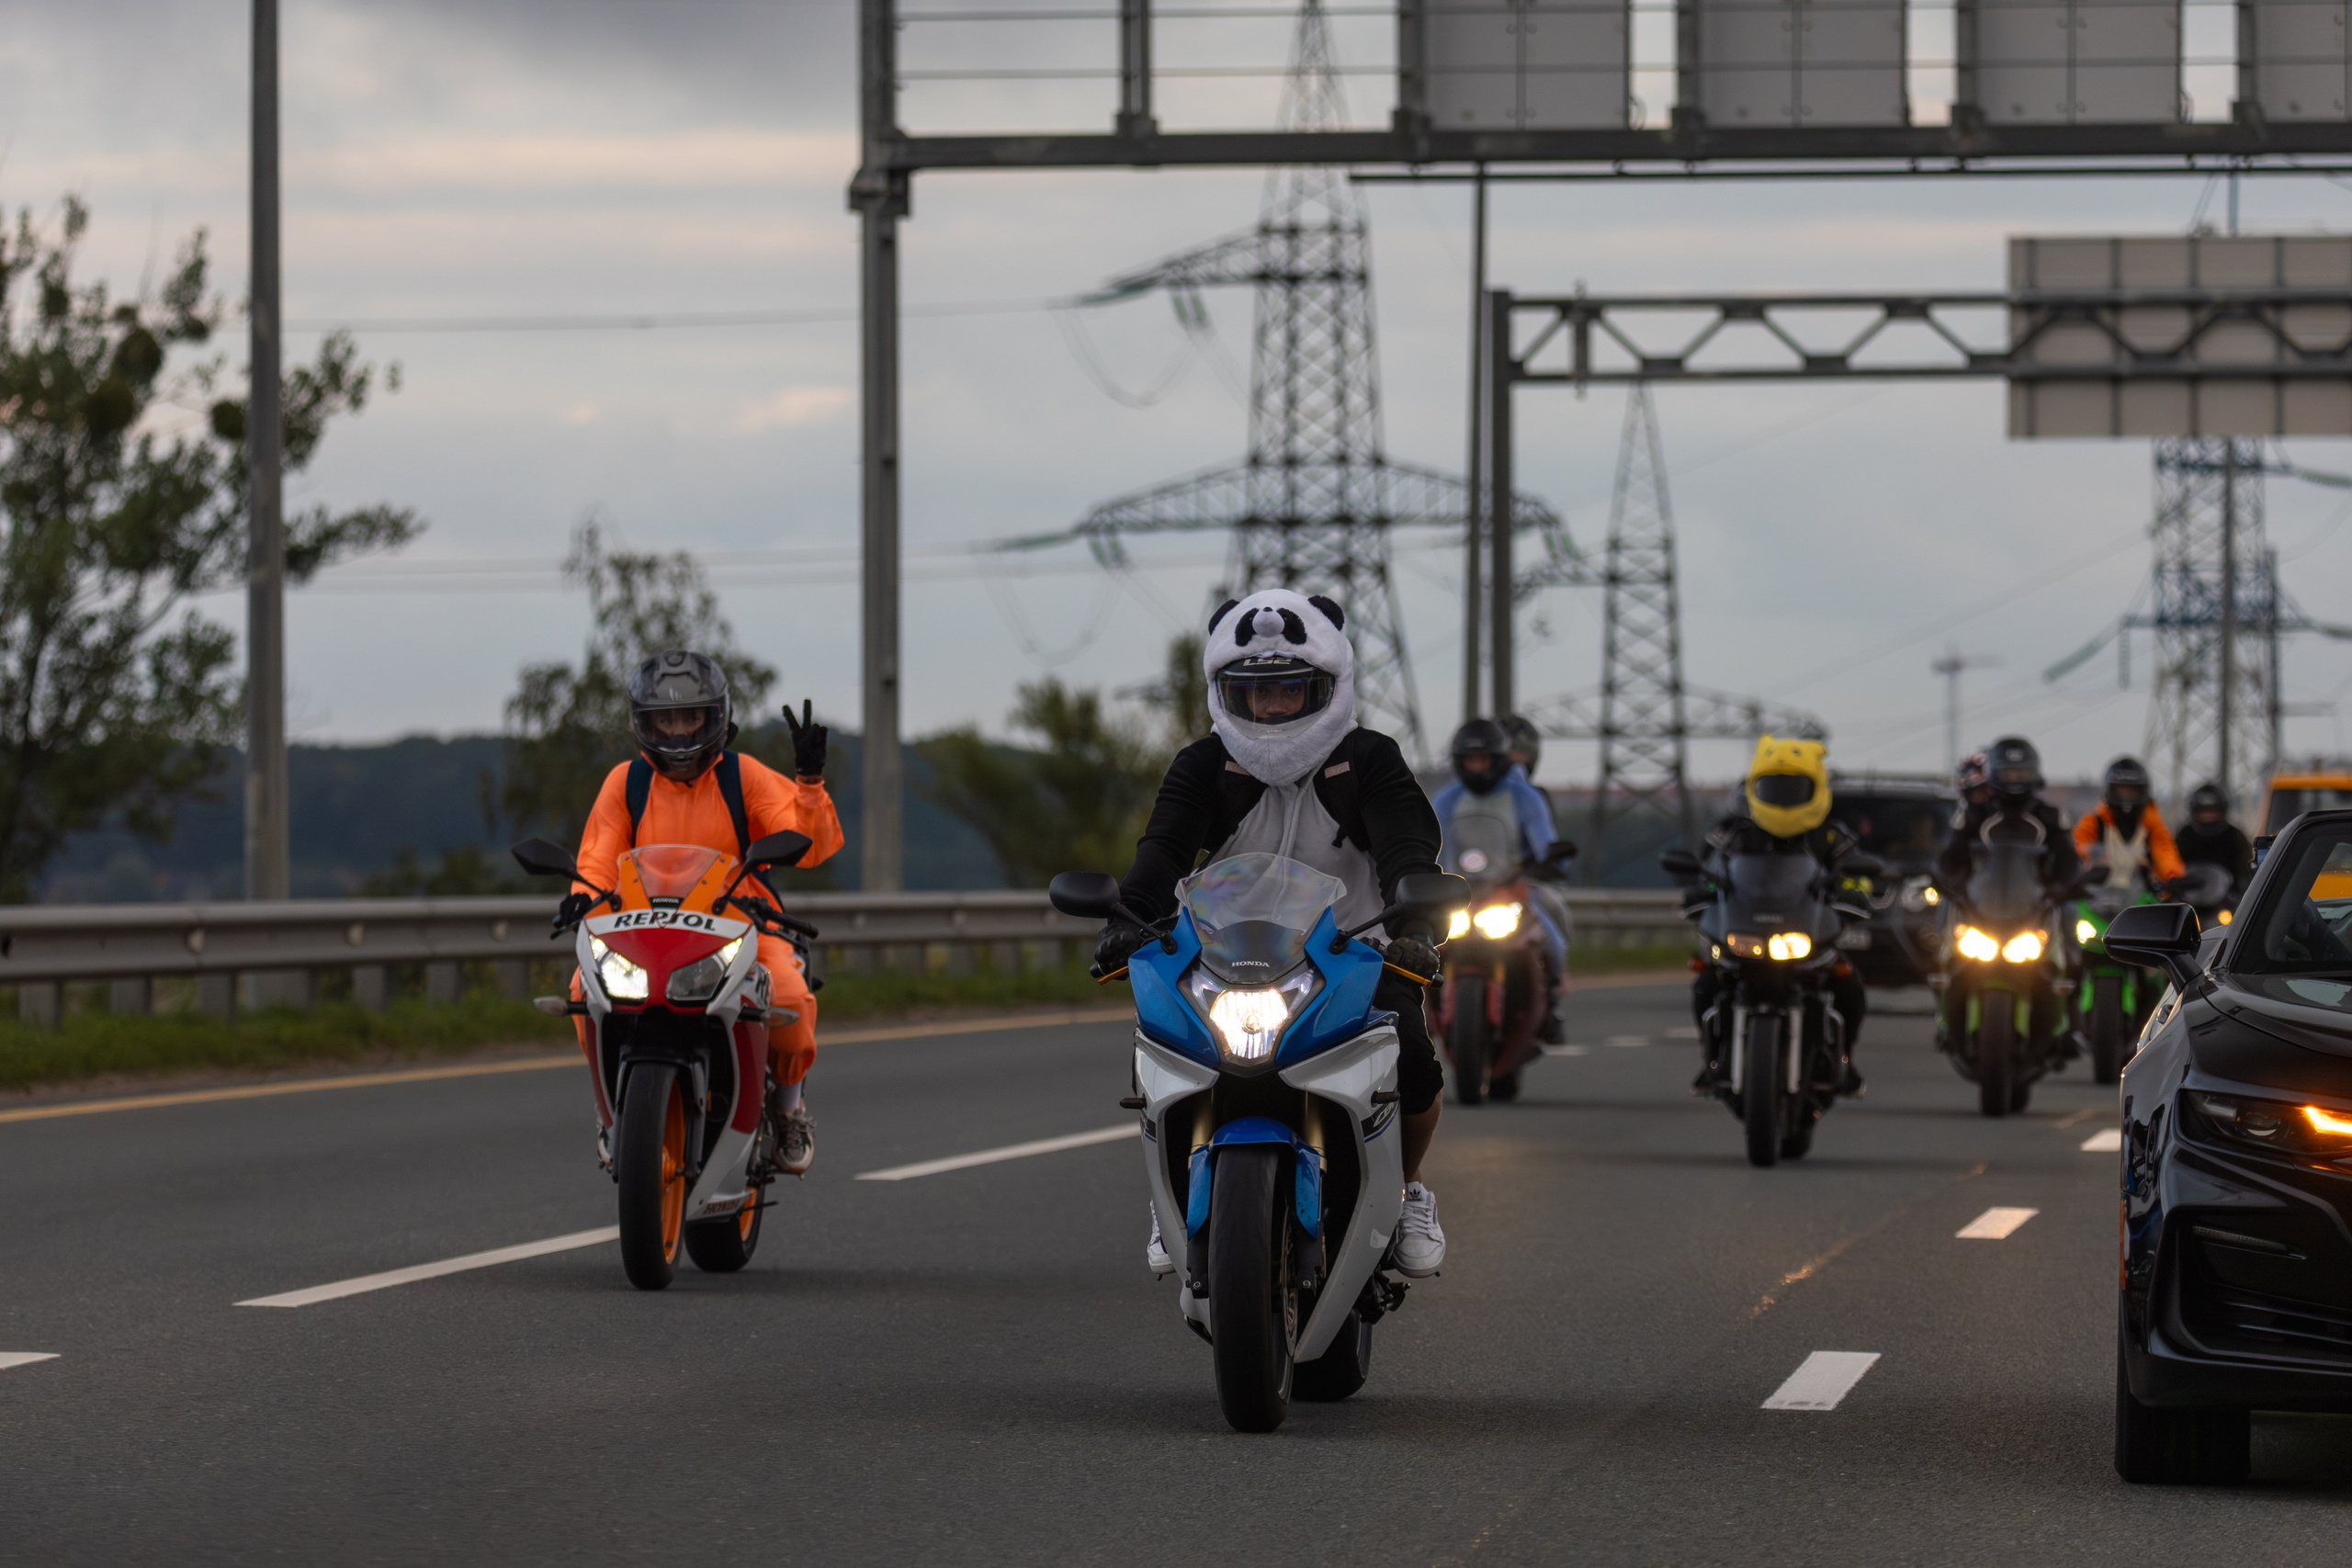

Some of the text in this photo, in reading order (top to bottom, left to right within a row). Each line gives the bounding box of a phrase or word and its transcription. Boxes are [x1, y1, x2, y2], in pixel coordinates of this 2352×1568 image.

[1243, 657, 1292, 666] LS2
[614, 911, 716, 931] REPSOL
[1231, 960, 1271, 968] HONDA
